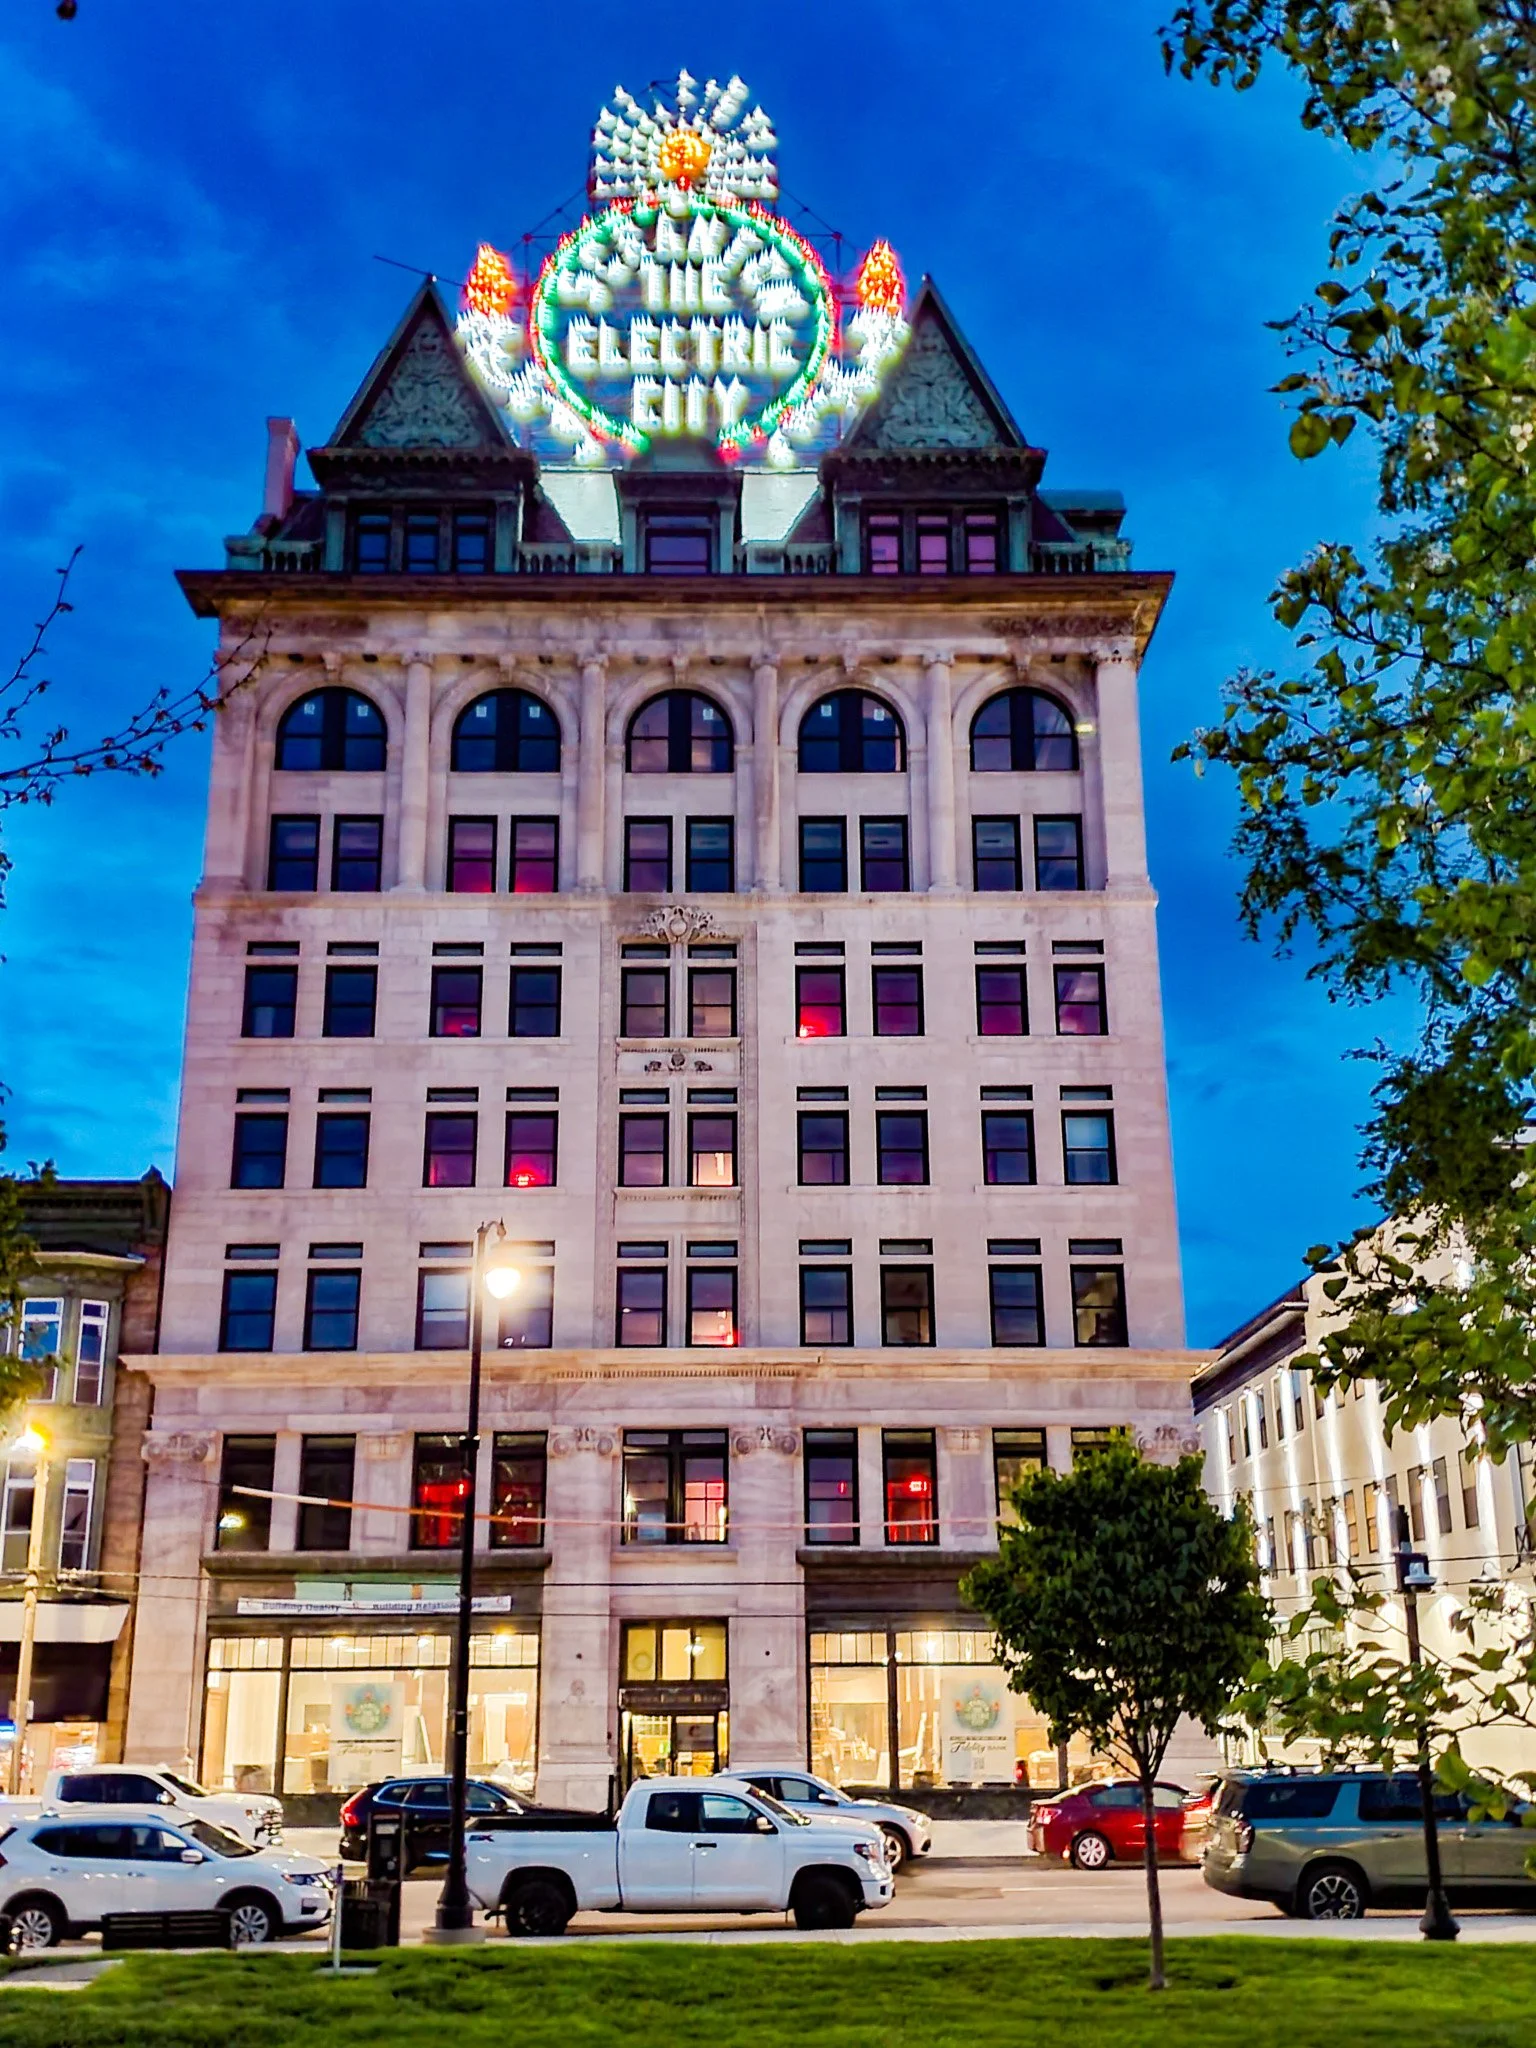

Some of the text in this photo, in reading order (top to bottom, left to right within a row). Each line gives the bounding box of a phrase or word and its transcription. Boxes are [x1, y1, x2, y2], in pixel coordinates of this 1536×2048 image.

[640, 252, 734, 312] THE
[566, 313, 801, 379] ELECTRIC
[631, 373, 750, 437] CITY
